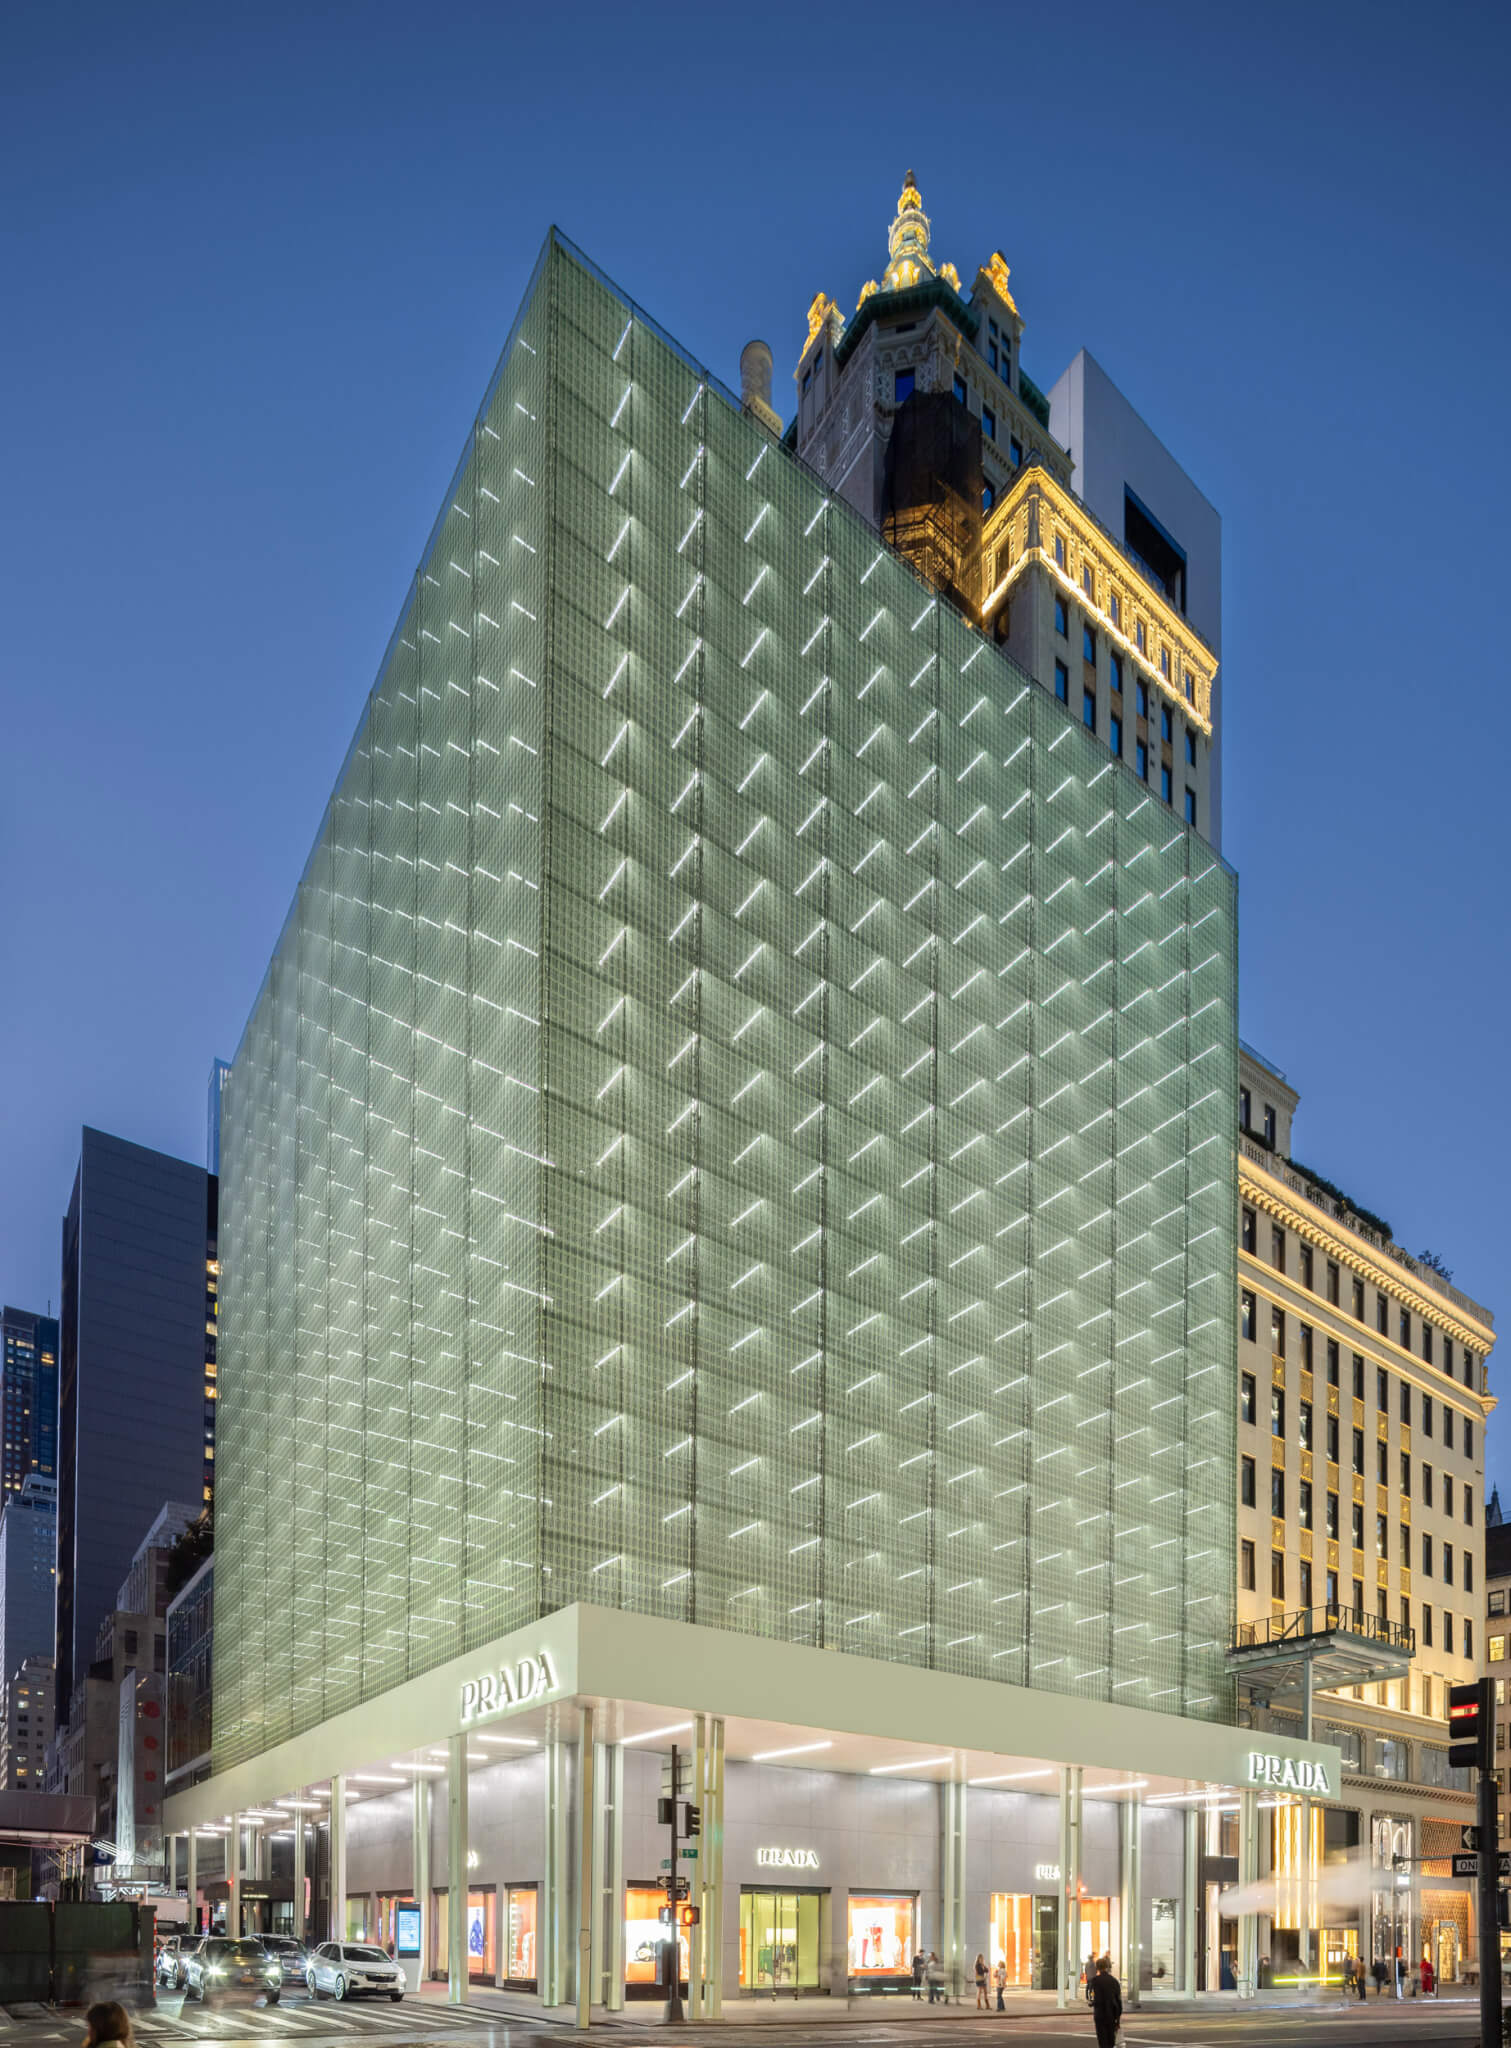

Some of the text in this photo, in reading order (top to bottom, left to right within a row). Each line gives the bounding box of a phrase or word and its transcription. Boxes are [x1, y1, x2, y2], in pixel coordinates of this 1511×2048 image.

[460, 1652, 558, 1722] PRADA
[1248, 1752, 1330, 1793] PRADA
[758, 1848, 819, 1867] PRADA
